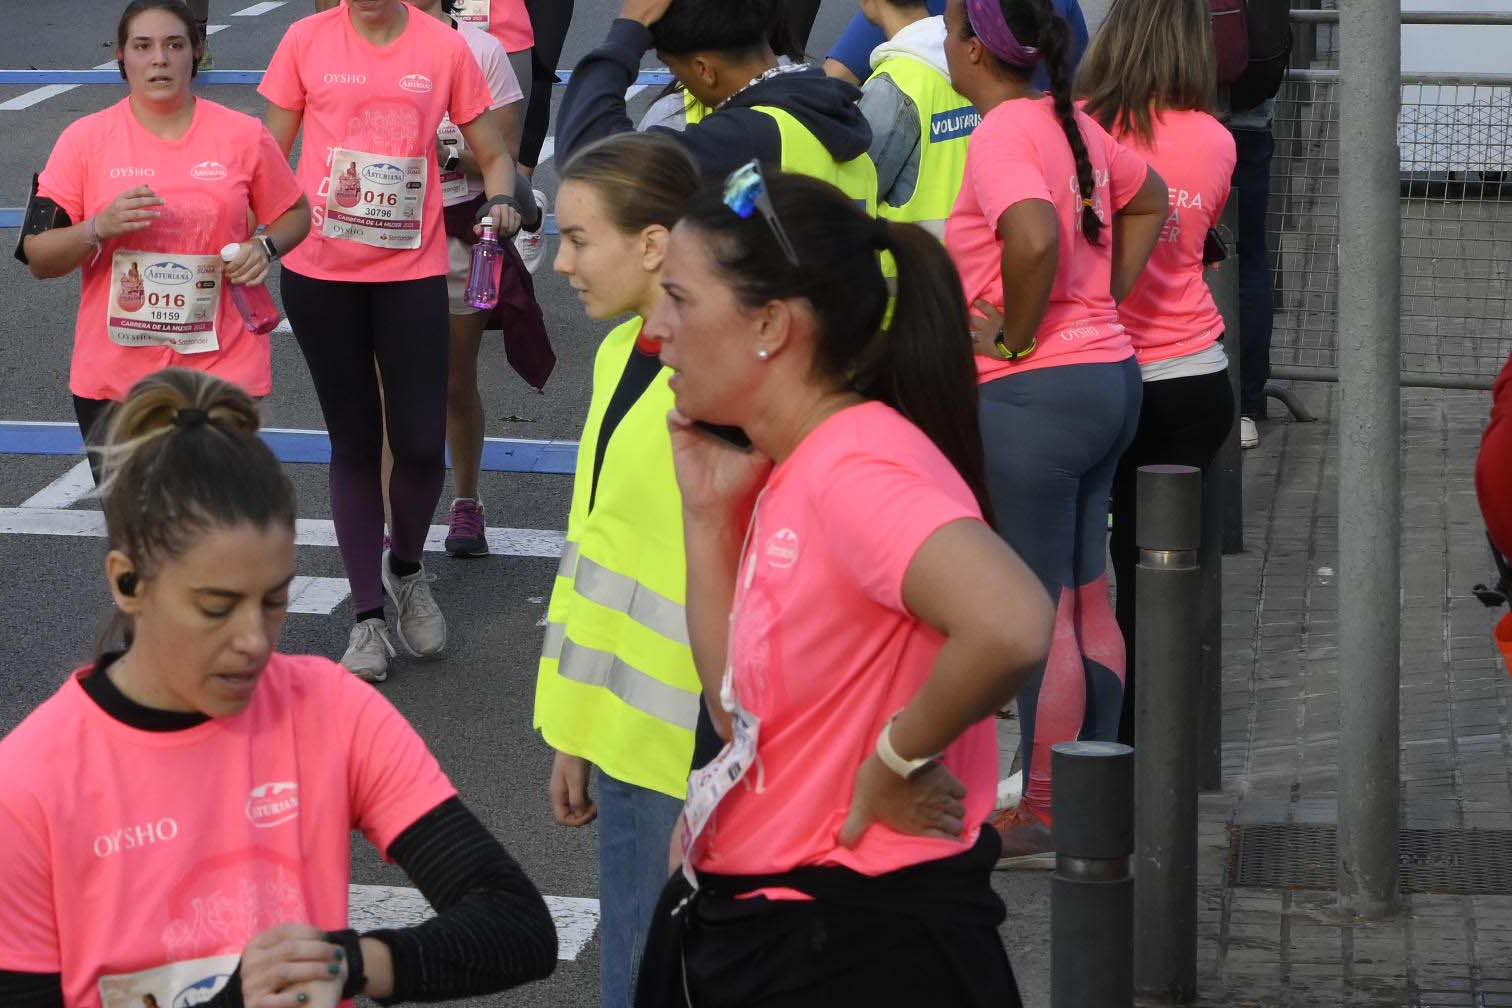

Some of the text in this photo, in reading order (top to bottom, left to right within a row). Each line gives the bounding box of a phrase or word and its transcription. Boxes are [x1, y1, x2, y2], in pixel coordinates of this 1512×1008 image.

[324, 73, 367, 84] OYSHO
[367, 171, 403, 181] ASTURIANA
[364, 191, 397, 206] 016
[148, 270, 190, 280] ASTURIANA
[148, 293, 185, 307] 016
[151, 311, 180, 320] 18159
[121, 321, 151, 330] CARRERA
[94, 817, 178, 857] OYSHO
